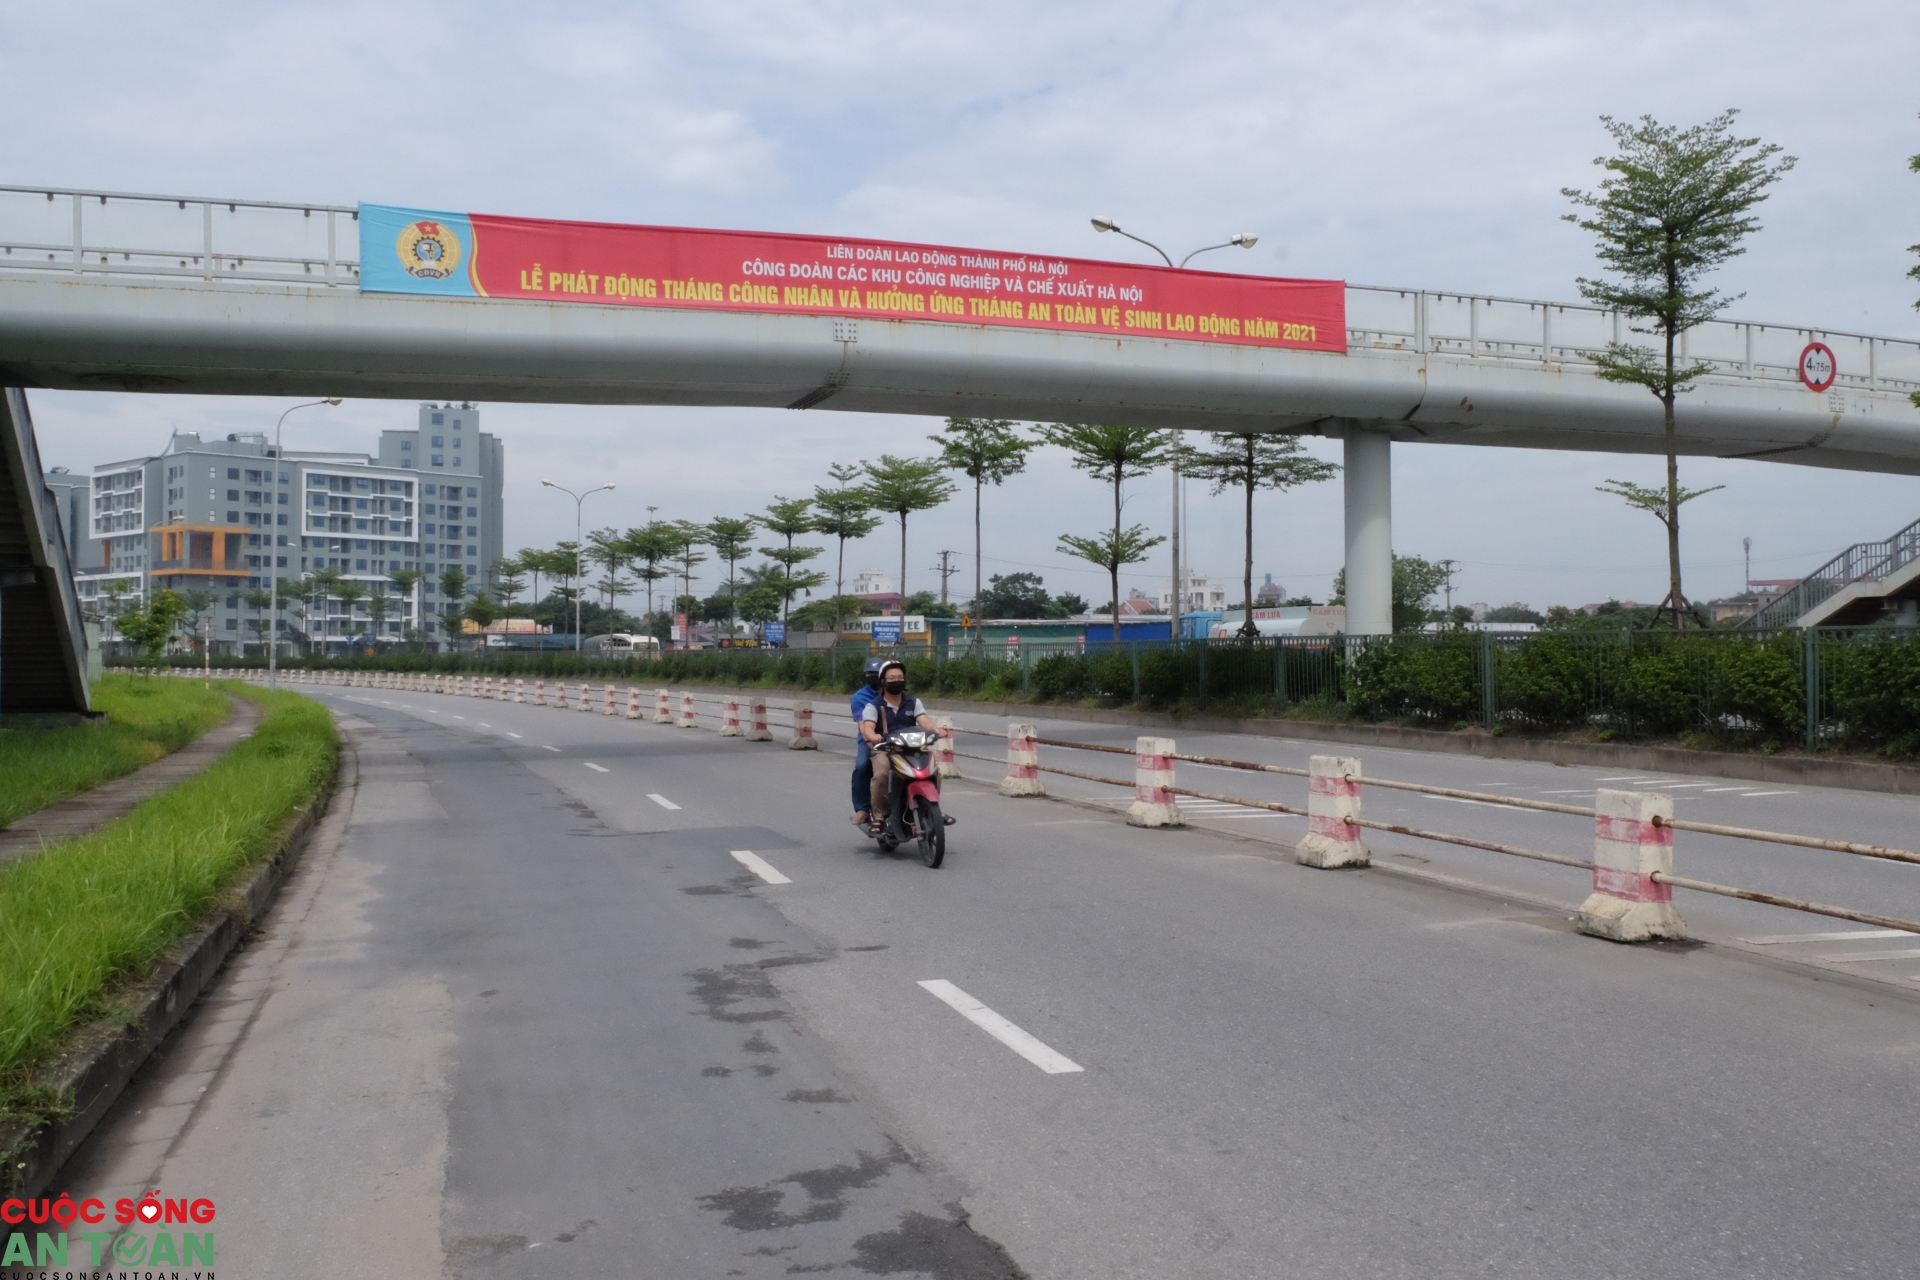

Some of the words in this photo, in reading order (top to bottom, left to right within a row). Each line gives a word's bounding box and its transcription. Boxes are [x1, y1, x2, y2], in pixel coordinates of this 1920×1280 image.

[827, 244, 853, 259] LIÊN
[856, 246, 892, 262] ĐOÀN
[895, 251, 919, 264] LAO
[922, 251, 957, 268] ĐỘNG
[960, 254, 1000, 270] THÀNH
[1003, 256, 1027, 272] PHỐ
[1029, 259, 1046, 274] HÀ
[1048, 261, 1068, 278] NỘI
[742, 258, 786, 277] CÔNG
[789, 262, 832, 279] ĐOÀN
[837, 264, 868, 282] CÁC
[871, 268, 902, 284] KHU
[906, 268, 946, 287] CÔNG
[950, 273, 1001, 293] NGHIỆP
[1004, 276, 1024, 292] VÀ
[1027, 277, 1054, 295] CHẾ
[1057, 279, 1095, 299] XUẤT
[1097, 284, 1117, 299] HÀ
[1120, 285, 1143, 305] NỘI
[521, 263, 543, 291] LỄ
[549, 270, 599, 294] PHÁT
[604, 273, 657, 300] ĐỘNG
[662, 277, 723, 303] THÁNG
[729, 281, 778, 304] CÔNG
[784, 284, 834, 307] NHÂN
[838, 287, 861, 308] VÀ
[866, 284, 925, 313] HƯỞNG
[929, 290, 965, 315] ỨNG
[969, 296, 1023, 319] THÁNG
[1028, 303, 1050, 321] AN
[1055, 303, 1097, 325] TOÀN
[1101, 305, 1120, 329] VỆ
[1125, 310, 1162, 330] SINH
[1166, 313, 1195, 332] LAO
[1199, 313, 1240, 338] ĐỘNG
[1245, 317, 1279, 339] NĂM
[1283, 323, 1316, 342] 2021
[1806, 357, 1830, 372] 4,75m
[843, 621, 873, 631] LEMO
